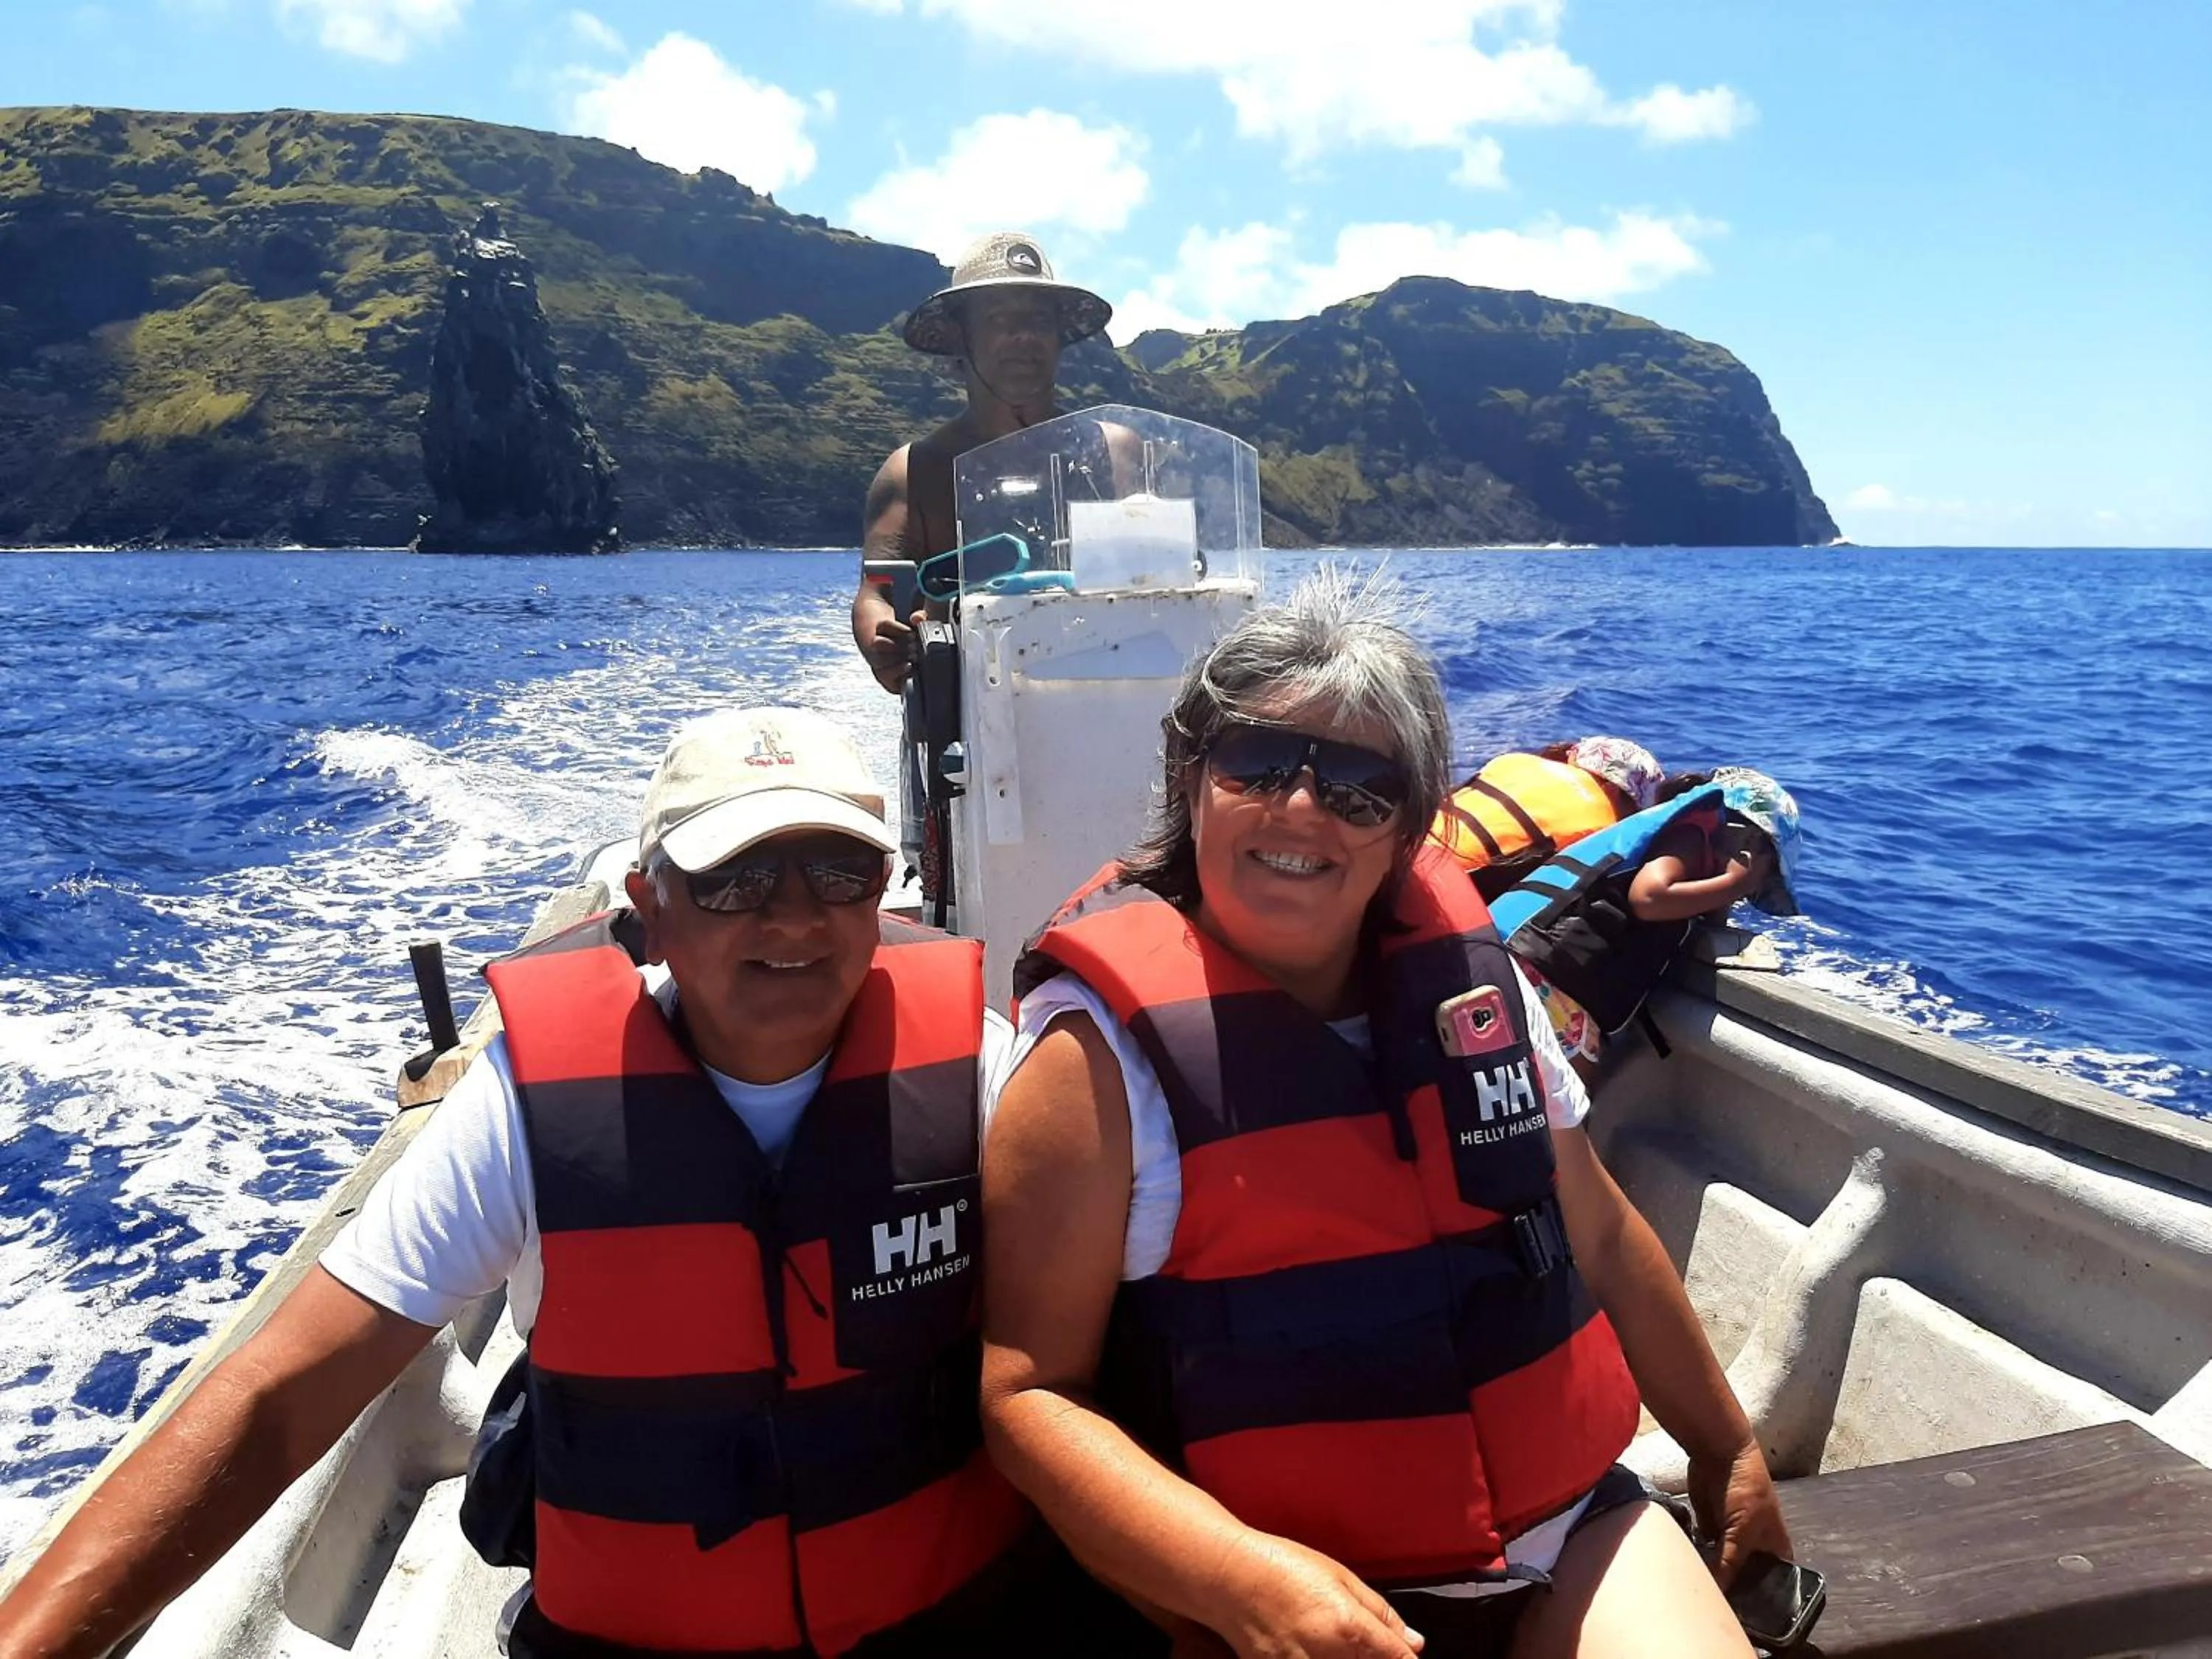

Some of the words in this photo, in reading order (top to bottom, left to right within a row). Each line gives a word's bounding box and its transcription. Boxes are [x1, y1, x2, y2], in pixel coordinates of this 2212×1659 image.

[1461, 1125, 1505, 1145] HELLY
[852, 1278, 905, 1301] HELLY
[911, 1254, 970, 1287] HANSEN
